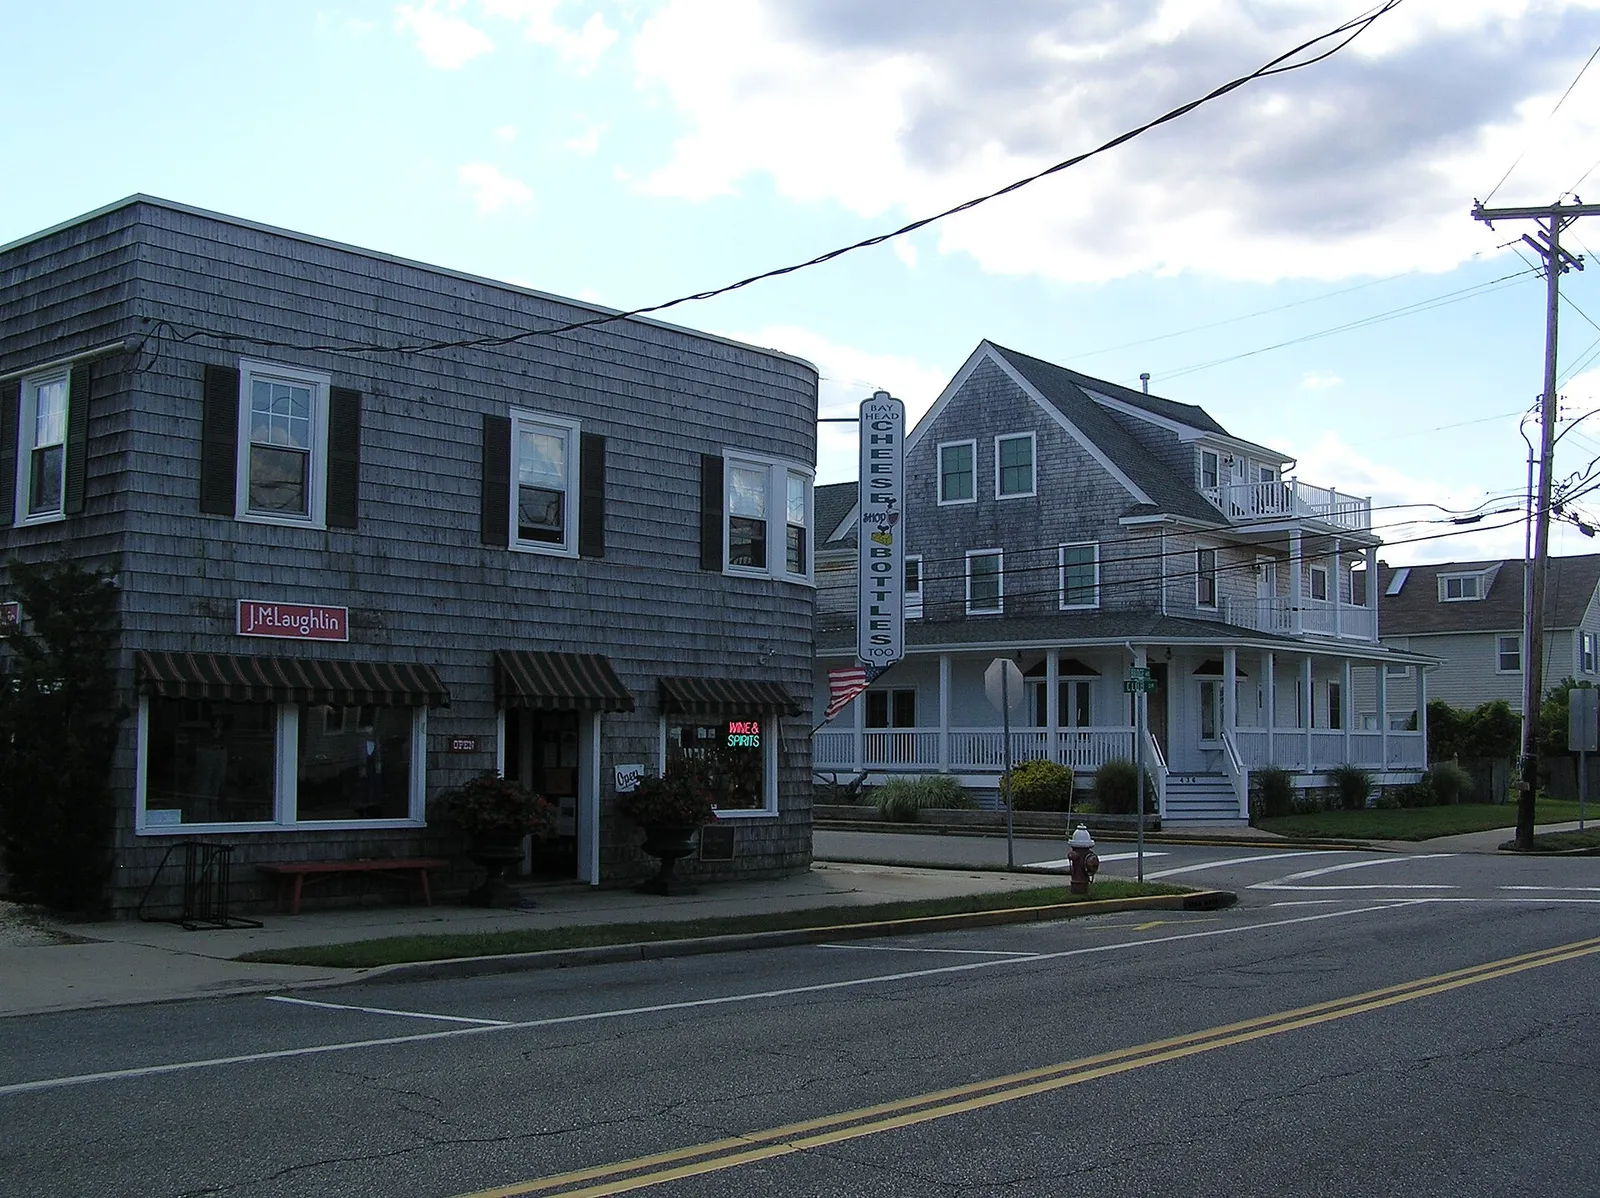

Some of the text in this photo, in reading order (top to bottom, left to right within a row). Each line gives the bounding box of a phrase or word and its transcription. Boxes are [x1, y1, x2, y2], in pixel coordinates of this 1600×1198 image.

[870, 404, 894, 412] BAY
[870, 420, 894, 504] CHEESE
[862, 512, 887, 523] SHOP
[869, 547, 893, 646] BOTTLES
[867, 648, 894, 657] TOO
[729, 721, 760, 735] WINE &
[453, 740, 475, 750] OPEN
[727, 734, 760, 748] SPIRITS
[617, 769, 639, 788] Open
